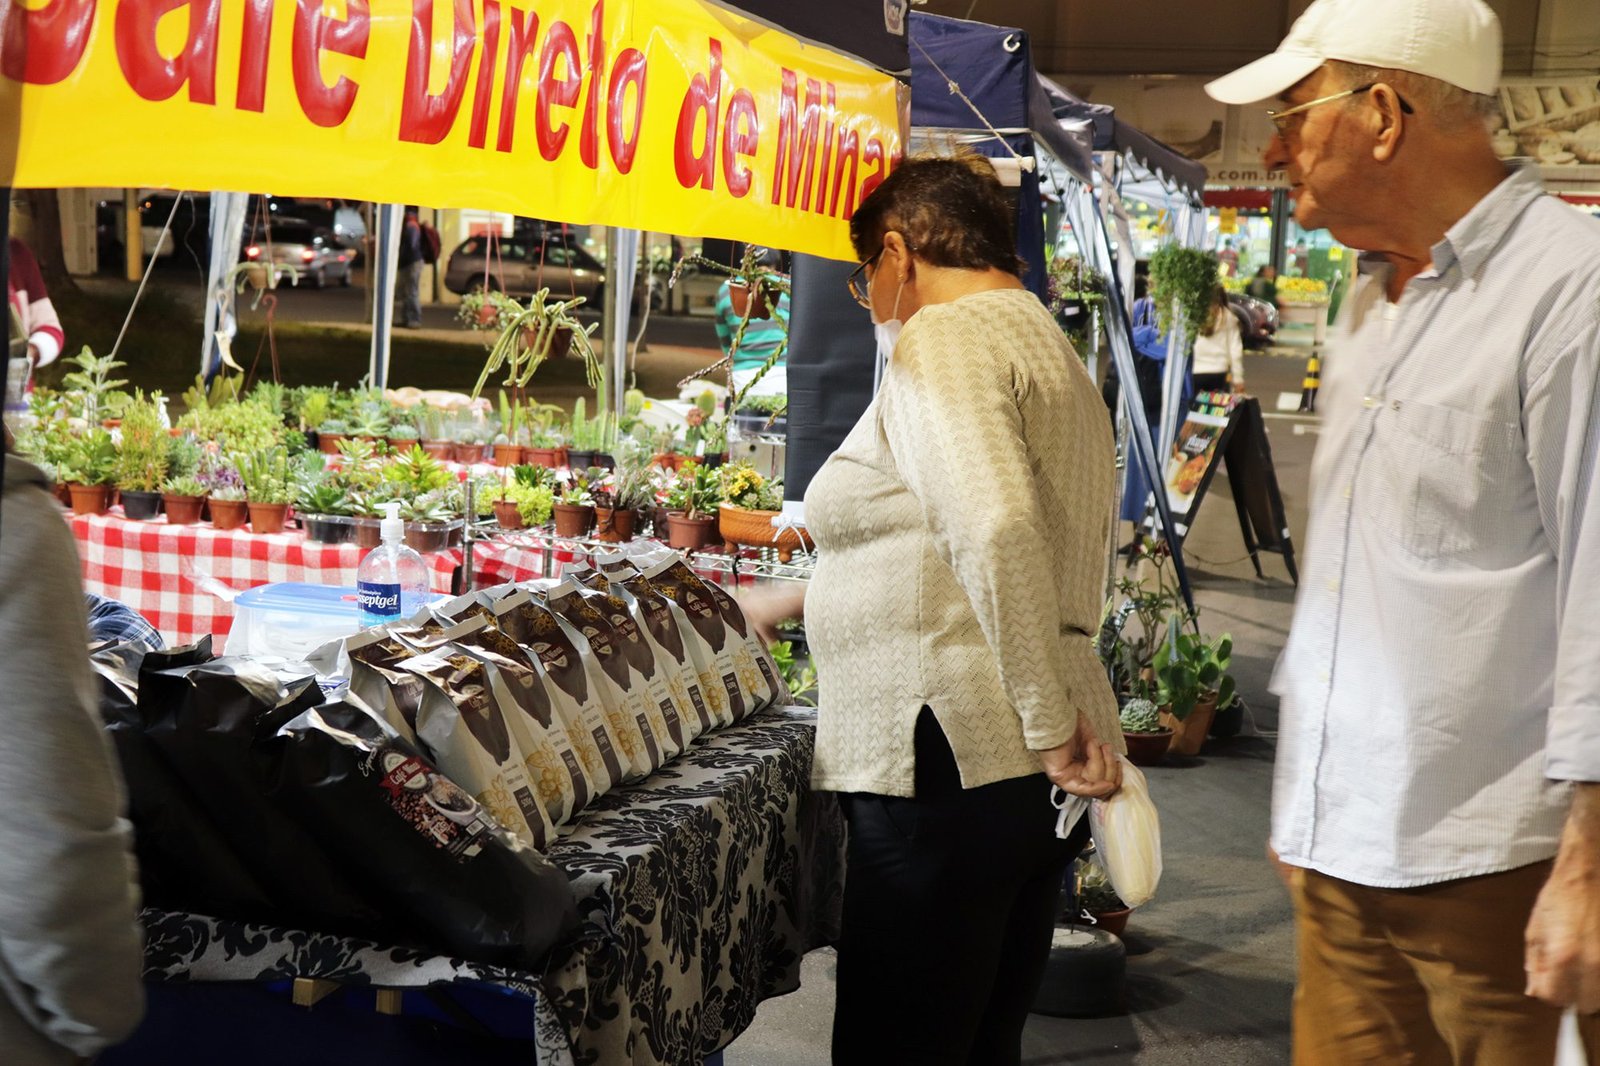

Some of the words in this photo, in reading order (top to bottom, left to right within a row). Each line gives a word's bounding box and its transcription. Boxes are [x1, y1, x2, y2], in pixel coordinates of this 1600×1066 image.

[398, 0, 647, 175] Direto
[674, 37, 758, 198] de
[1208, 169, 1285, 181] .com.br
